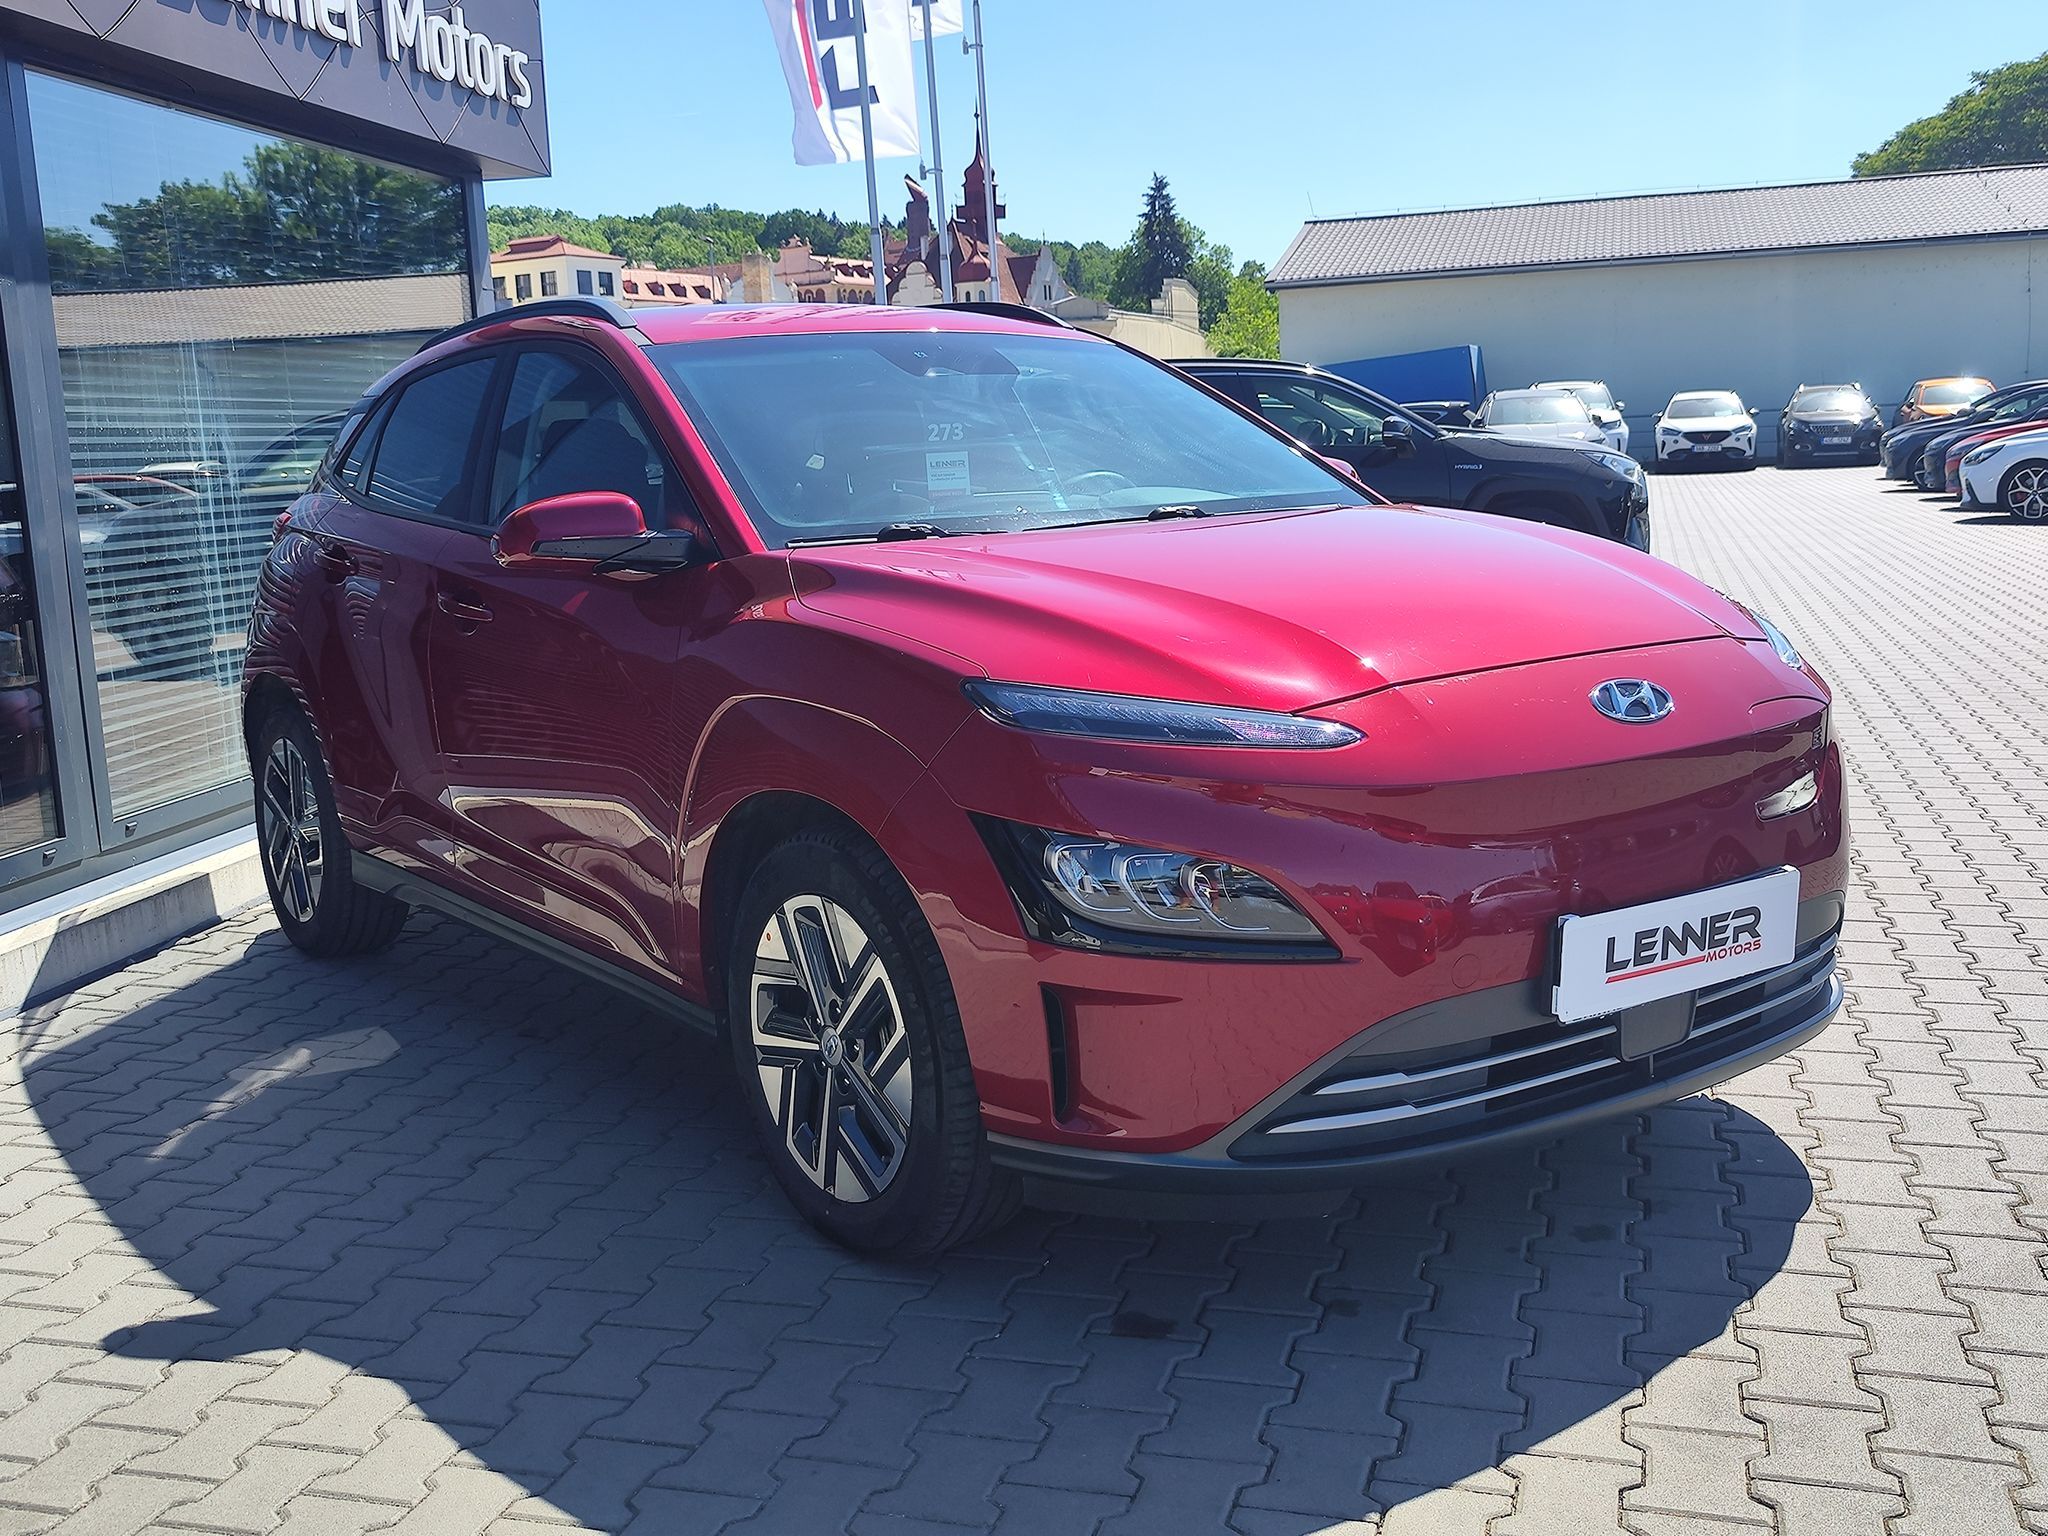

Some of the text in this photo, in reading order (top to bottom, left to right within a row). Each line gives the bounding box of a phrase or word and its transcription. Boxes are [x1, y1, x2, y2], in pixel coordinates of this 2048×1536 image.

[383, 0, 532, 109] Motors
[927, 422, 964, 441] 273
[1605, 906, 1762, 973] LENNER
[1705, 938, 1762, 963] MOTORS
